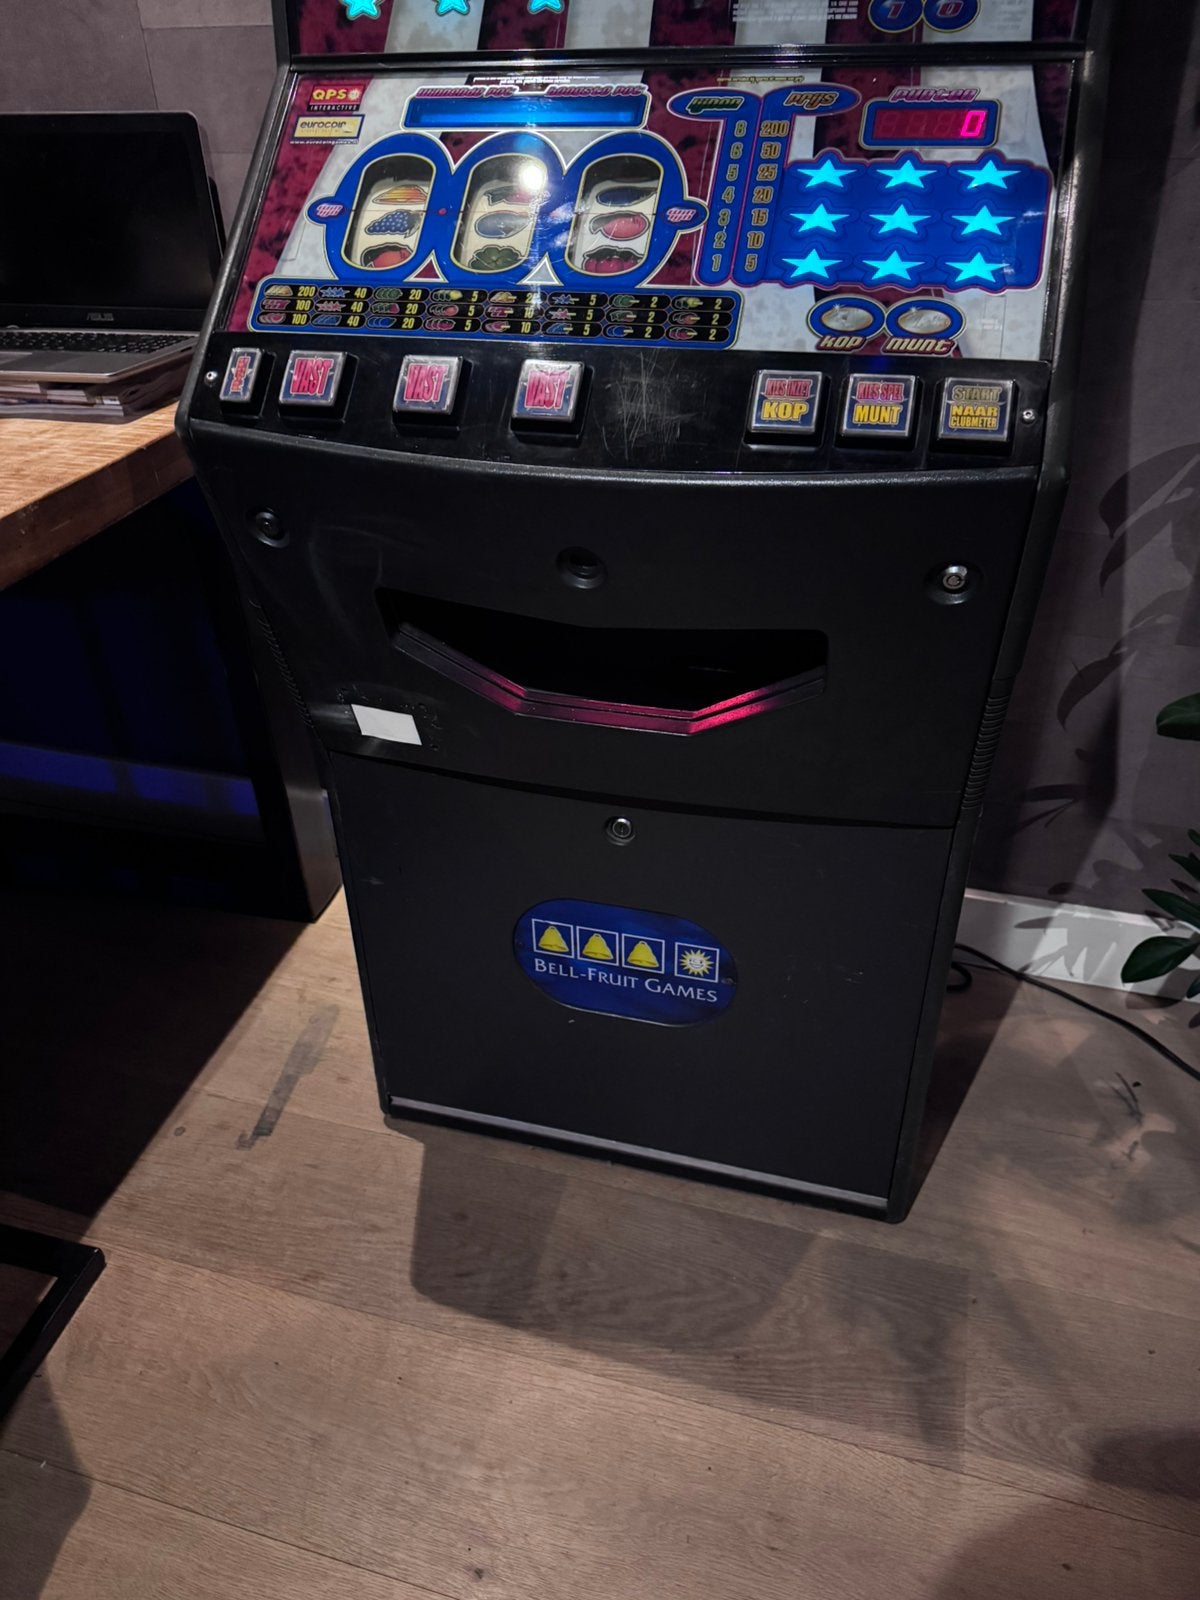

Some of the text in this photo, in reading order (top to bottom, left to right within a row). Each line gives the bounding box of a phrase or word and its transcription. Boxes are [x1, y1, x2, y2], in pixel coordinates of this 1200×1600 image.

[312, 88, 347, 101] QPS
[785, 91, 838, 112] prijs
[889, 87, 979, 102] punten
[760, 121, 789, 137] 200
[961, 111, 987, 138] 0
[730, 142, 780, 158] 6 50
[726, 164, 778, 181] 5 25
[722, 186, 773, 203] 4 20
[718, 209, 768, 226] 3 15
[714, 232, 764, 248] 2 10
[712, 255, 758, 271] 1 5
[297, 287, 315, 297] 200
[354, 288, 367, 298] 40
[409, 289, 422, 299] 20
[471, 291, 478, 301] 5
[589, 295, 597, 305] 5
[650, 297, 657, 307] 2
[714, 299, 722, 309] 2
[295, 300, 310, 310] 100
[351, 302, 363, 312] 40
[405, 304, 418, 314] 20
[468, 305, 475, 316] 5
[586, 310, 594, 320] 5
[647, 312, 655, 322] 2
[712, 315, 719, 325] 2
[292, 314, 716, 340] 100 40 20 5 10 5 2 2
[818, 336, 864, 350] kop
[885, 337, 953, 352] munt
[290, 358, 334, 395] VAST
[404, 363, 449, 402] VAST
[525, 371, 570, 409] VAST
[857, 383, 904, 401] KIES SPEL
[953, 386, 1002, 401] START
[763, 402, 808, 420] KOP
[854, 405, 902, 424] MUNT
[951, 405, 999, 416] NAAR
[950, 416, 998, 428] CLUBMETER
[645, 978, 718, 1003] GAMES
